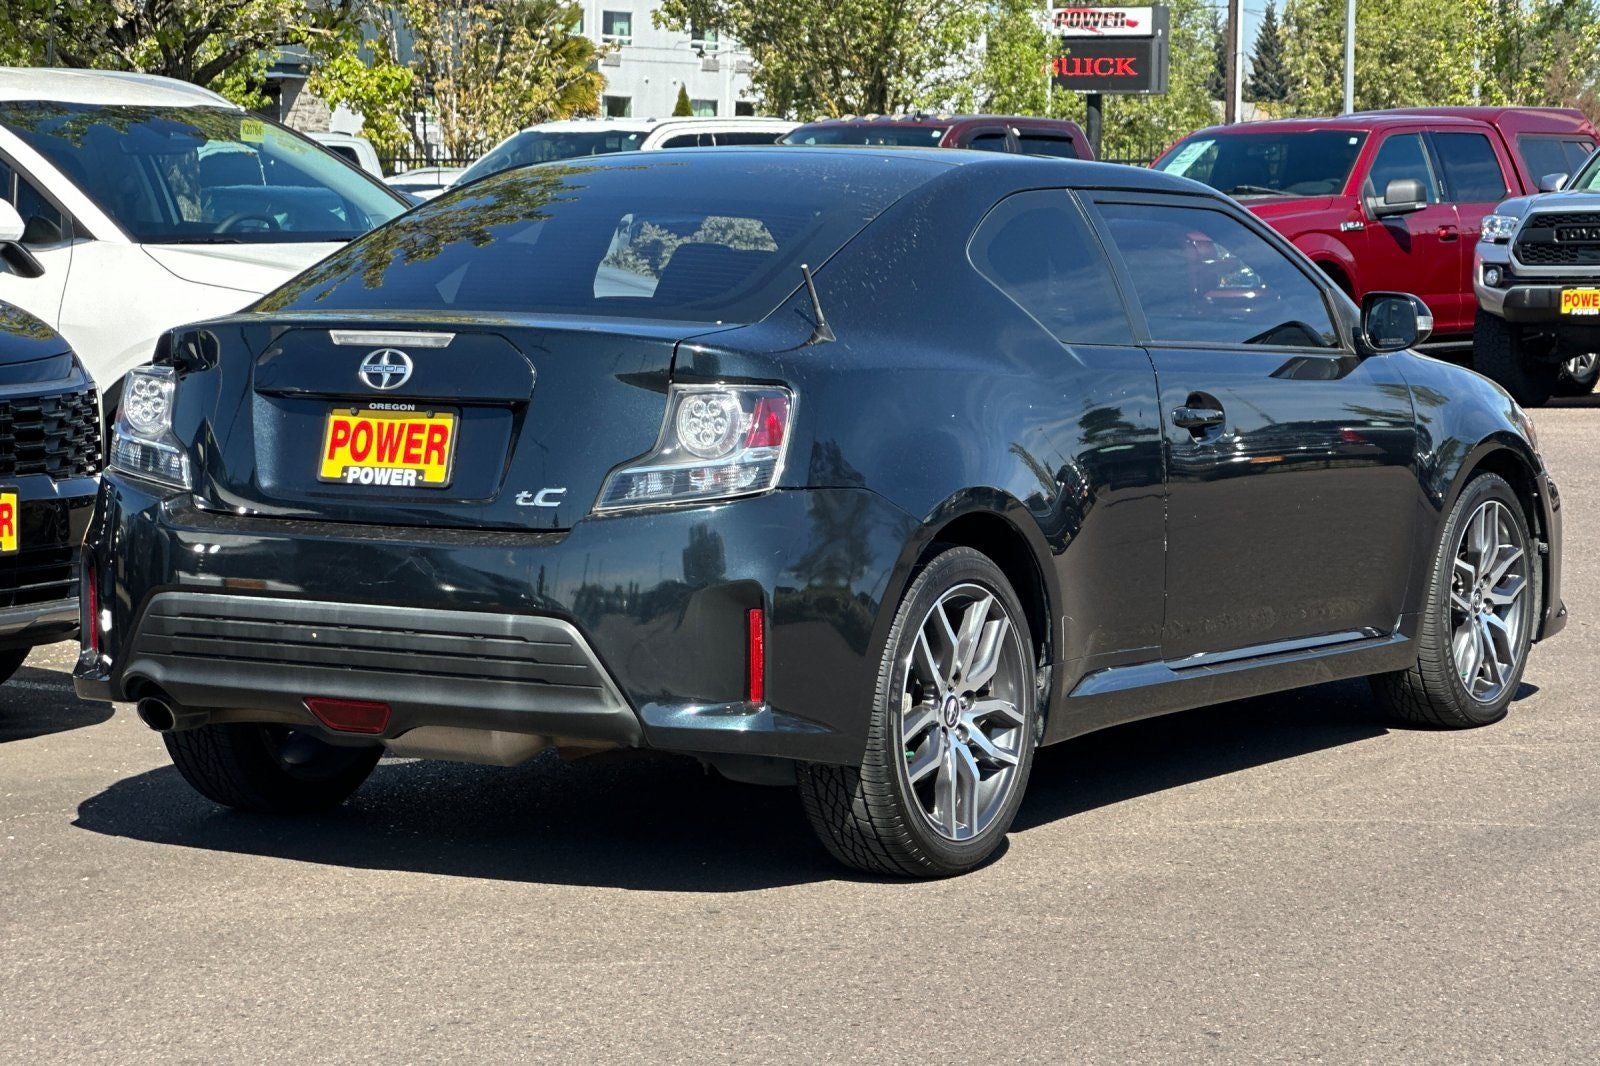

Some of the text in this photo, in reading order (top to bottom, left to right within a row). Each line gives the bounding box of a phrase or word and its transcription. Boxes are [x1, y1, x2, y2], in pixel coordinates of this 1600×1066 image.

[1055, 11, 1126, 29] POWER
[1564, 293, 1600, 307] POWE
[368, 402, 416, 411] OREGON
[327, 420, 449, 466] POWER
[346, 466, 418, 486] POWER
